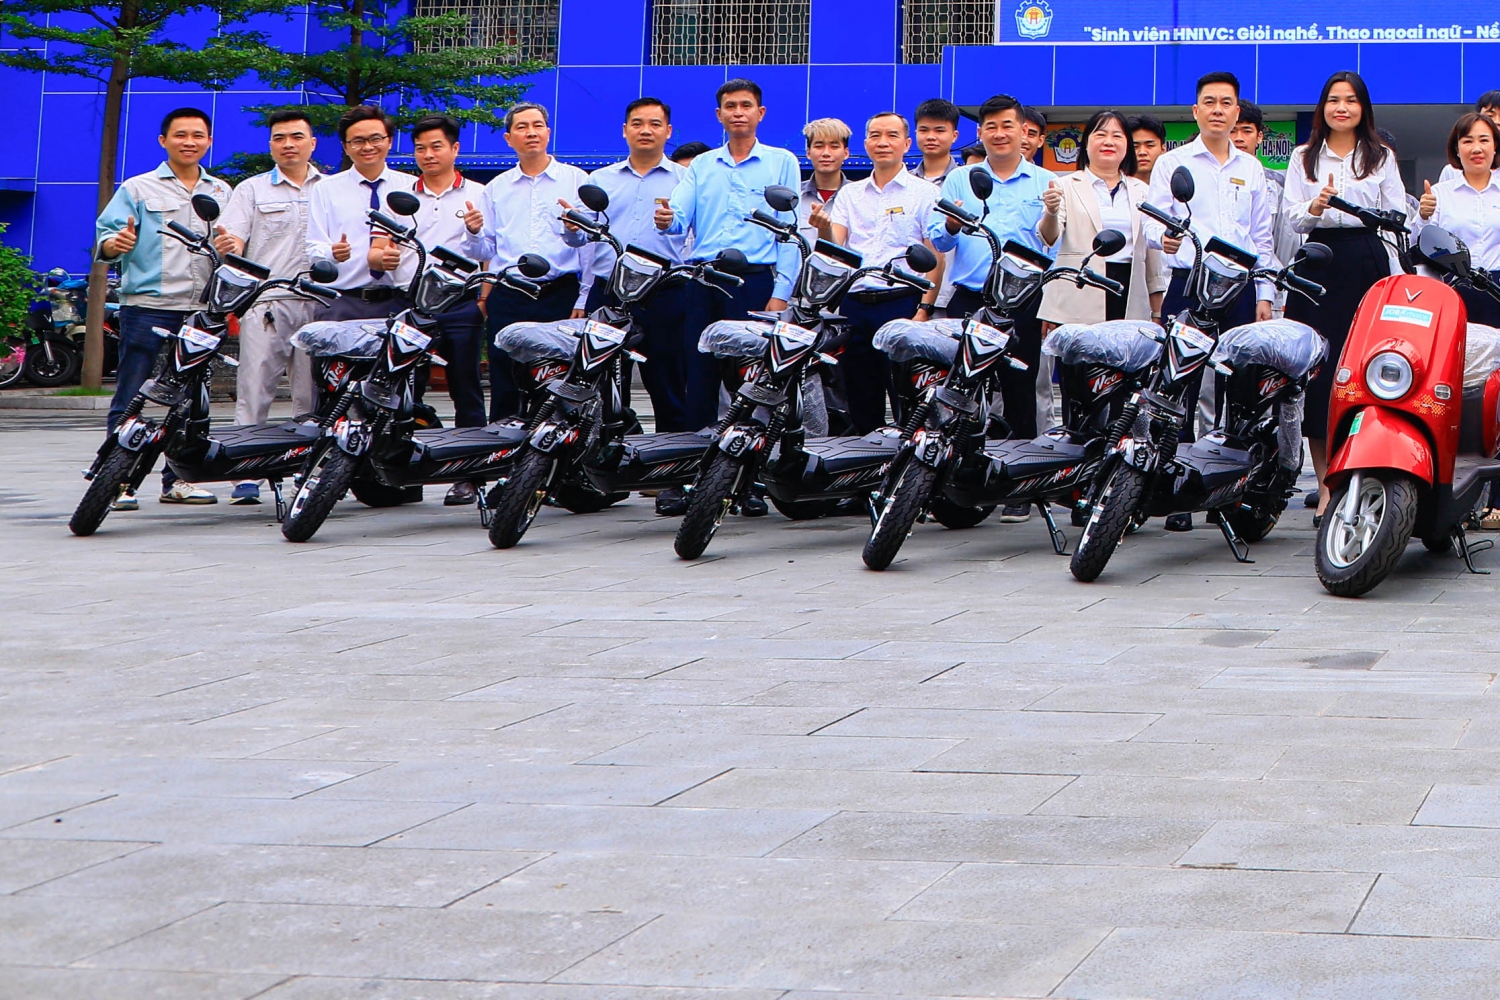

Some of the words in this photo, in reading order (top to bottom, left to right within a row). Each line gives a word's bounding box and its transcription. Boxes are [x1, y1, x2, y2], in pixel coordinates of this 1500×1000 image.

[1132, 26, 1170, 41] viên
[1173, 27, 1235, 41] HNIVC:
[1237, 24, 1270, 41] Giỏi
[1262, 136, 1273, 156] HÀ
[1275, 137, 1291, 159] NỘI
